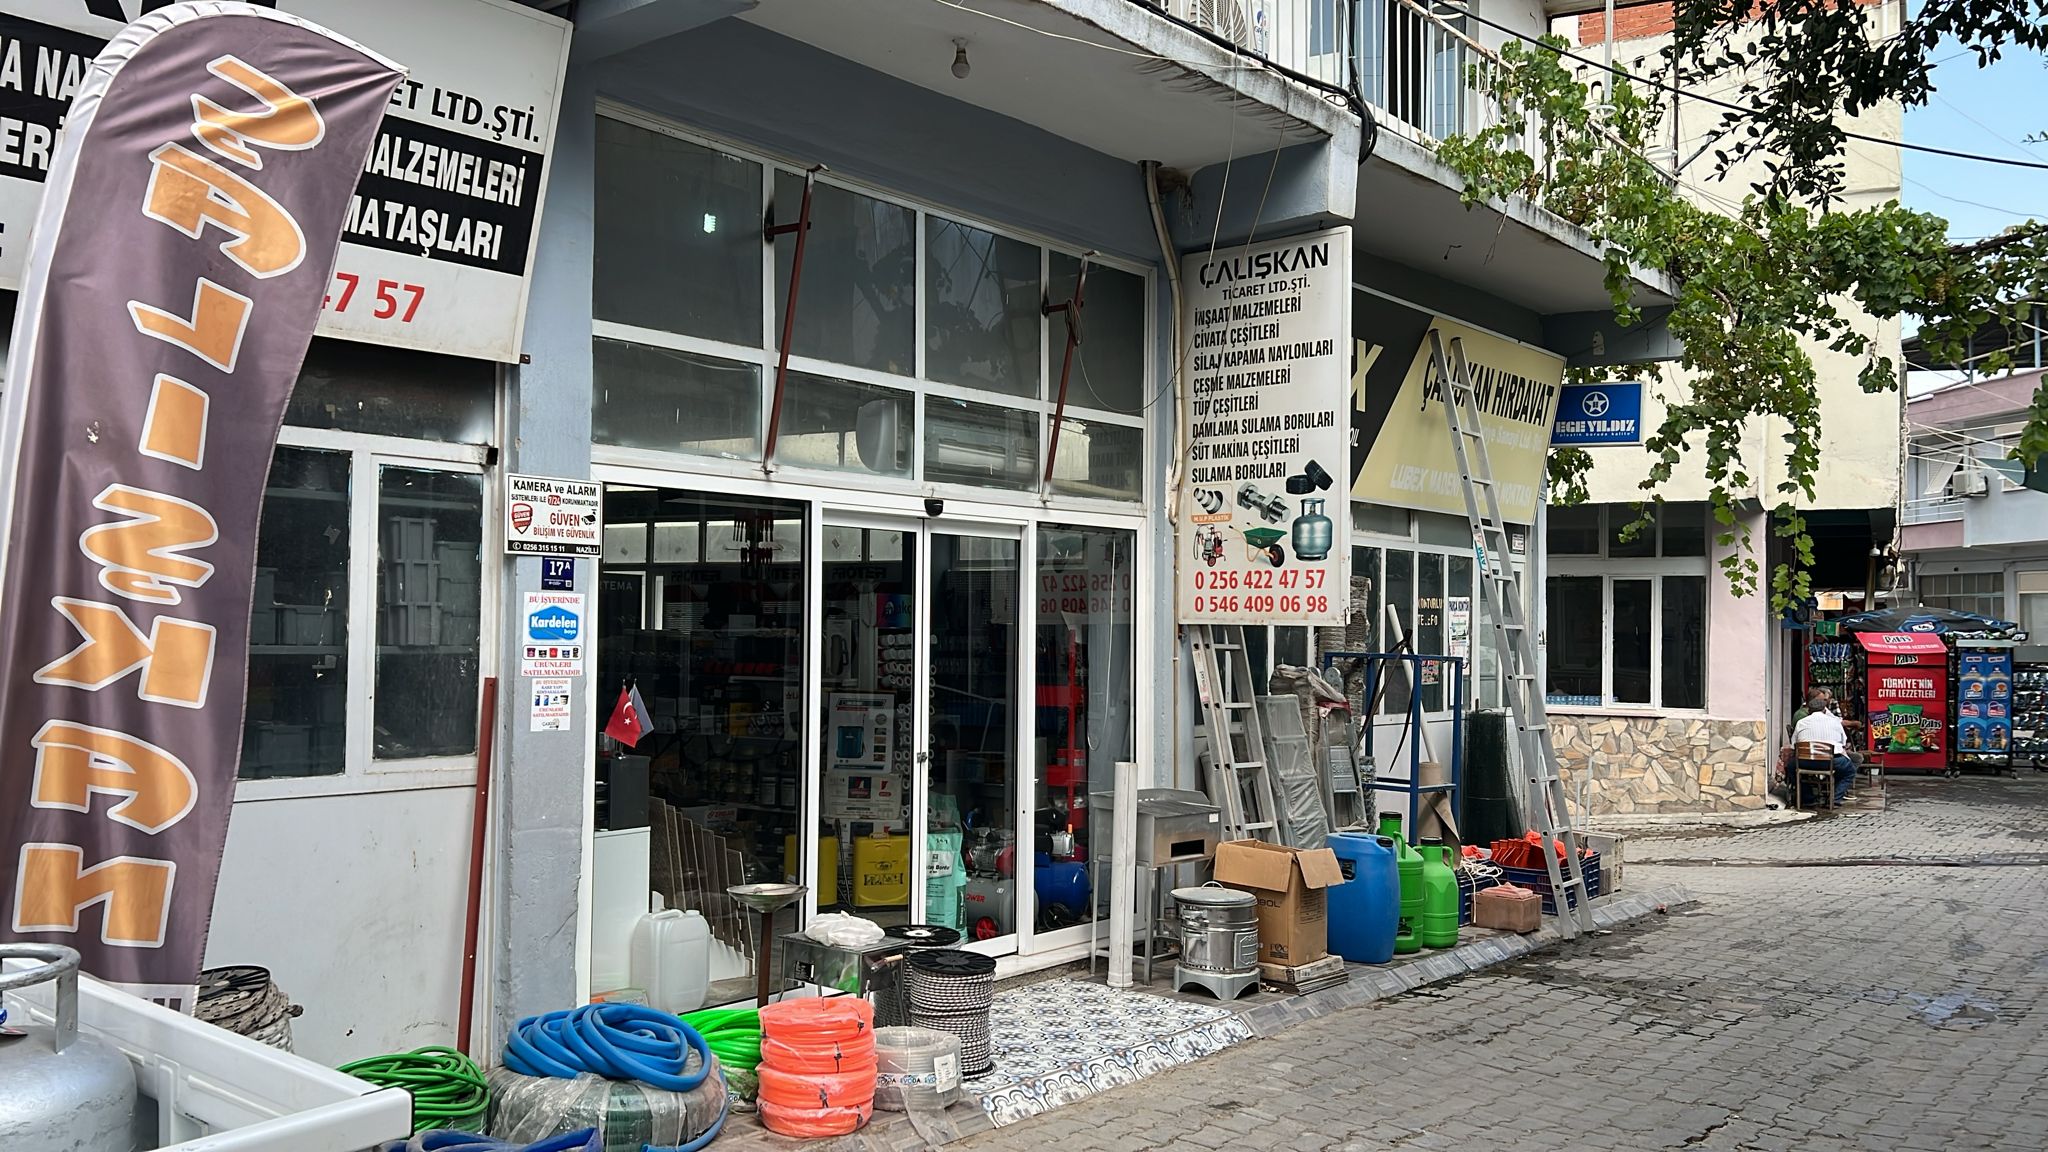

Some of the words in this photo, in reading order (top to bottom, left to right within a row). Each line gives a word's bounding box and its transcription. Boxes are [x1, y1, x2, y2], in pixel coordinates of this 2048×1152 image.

[0, 36, 22, 92] A
[431, 88, 539, 143] LTD.ŞTİ.
[1200, 242, 1329, 289] ÇALIŞKAN
[322, 272, 360, 313] 7
[373, 279, 425, 323] 57
[1222, 283, 1265, 300] TİCARET
[1268, 274, 1311, 294] LTD.ŞTİ.
[1194, 308, 1230, 328] İNŞAAT
[1232, 292, 1301, 321] MALZEMELERİ
[1230, 319, 1279, 348] ÇEŞİTLERİ
[1193, 354, 1221, 371] SİLAJ
[1224, 348, 1265, 368] KAPAMA
[1268, 339, 1333, 363] NAYLONLARI
[1193, 376, 1224, 397] ÇEŞME
[1226, 364, 1291, 390] MALZEMELERİ
[1193, 397, 1210, 416] TÜP
[1213, 391, 1259, 418] ÇEŞİTLERİ
[1491, 370, 1555, 428] HIRDAVAT
[1192, 420, 1238, 438] DAMLAMA
[1241, 415, 1281, 434] SULAMA
[1284, 411, 1334, 430] BORULARI
[1555, 421, 1585, 433] EGE
[1587, 420, 1634, 432] YILDIZ
[1192, 441, 1209, 461] SÜT
[1212, 438, 1249, 459] MAKİNA
[1252, 434, 1300, 461] ÇEŞİTLERİ
[1192, 467, 1232, 483] SULAMA
[1235, 462, 1286, 480] BORULARI
[513, 479, 552, 493] KAMERA
[555, 486, 564, 494] ve
[566, 485, 596, 497] ALARM
[550, 510, 580, 526] GÜVEN
[533, 525, 555, 538] BİLİŞİM
[557, 529, 564, 537] VE
[566, 527, 595, 539] GÜVENLİK
[523, 543, 537, 551] 0256
[1195, 572, 1204, 589] 0
[1209, 571, 1238, 589] 256
[1243, 570, 1273, 589] 422
[1279, 570, 1299, 588] 47
[1305, 569, 1326, 588] 57
[541, 595, 580, 604] İŞYERİNDE
[1194, 596, 1204, 612] 0
[1209, 596, 1238, 612] 546
[1244, 596, 1274, 612] 409
[1280, 596, 1300, 612] 06
[1306, 596, 1327, 612] 98
[531, 615, 576, 628] Kardelen
[1878, 689, 1896, 698] ÇITIR
[1898, 689, 1936, 698] LEZZETLERİ
[1882, 677, 1933, 689] TÜRKİYE'NİN
